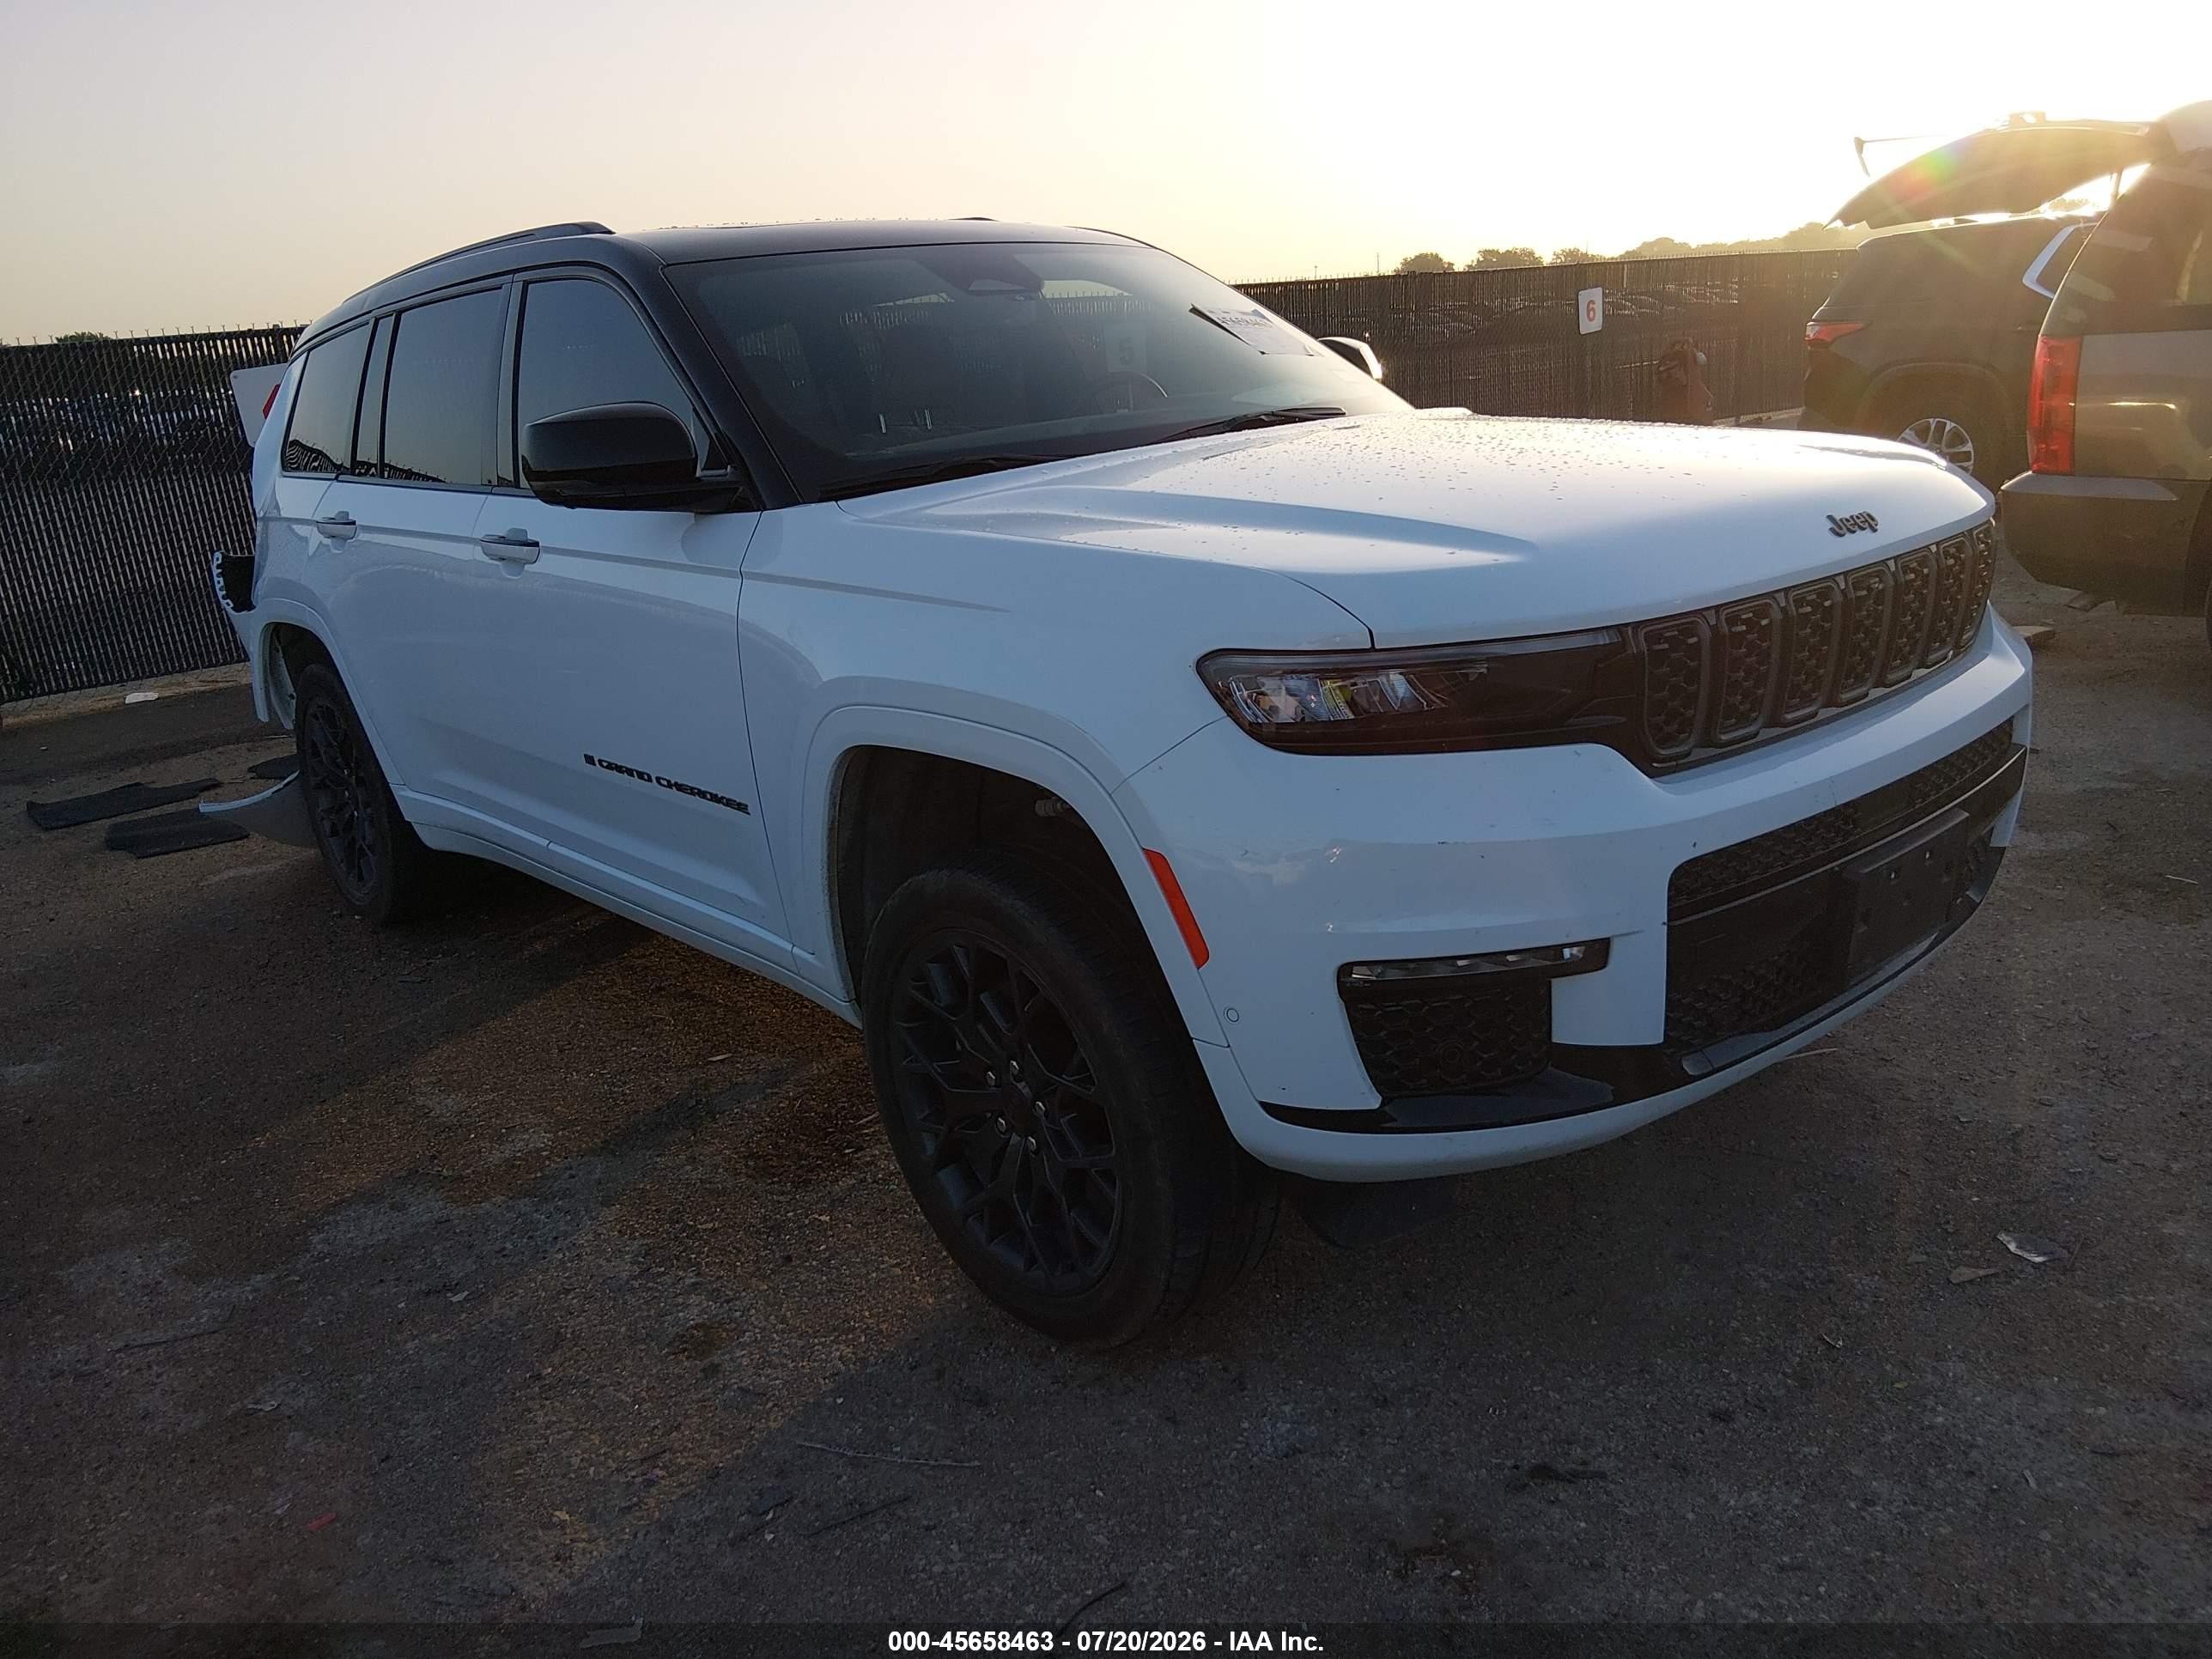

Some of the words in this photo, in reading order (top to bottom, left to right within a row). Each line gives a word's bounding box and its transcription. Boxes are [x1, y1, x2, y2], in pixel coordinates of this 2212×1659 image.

[1586, 300, 1596, 323] 6
[1826, 511, 1879, 538] Jeep
[598, 758, 653, 783] GRAND
[655, 776, 750, 816] CHEROKEE
